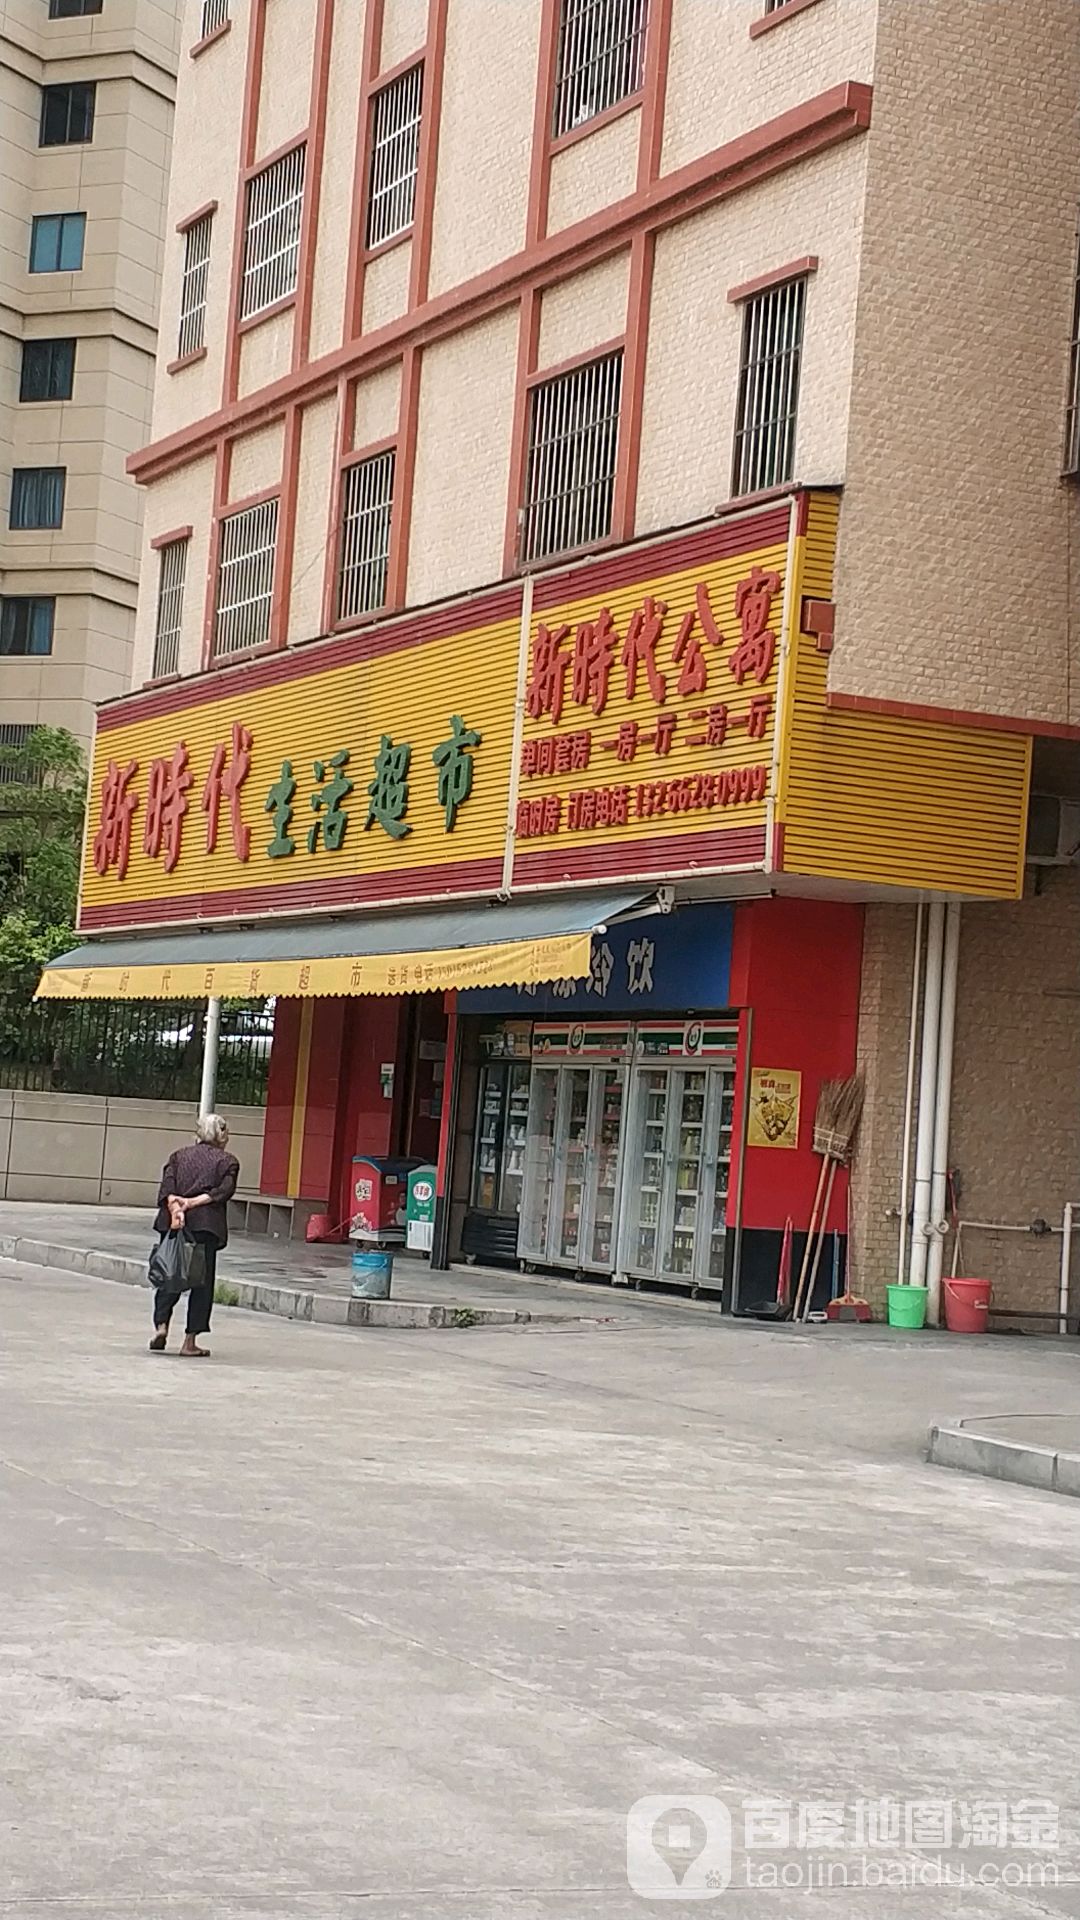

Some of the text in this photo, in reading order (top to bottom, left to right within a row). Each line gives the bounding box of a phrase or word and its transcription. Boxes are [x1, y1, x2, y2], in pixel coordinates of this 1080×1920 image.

[522, 693, 773, 779] 单间套房 一房一厅 二房一厅
